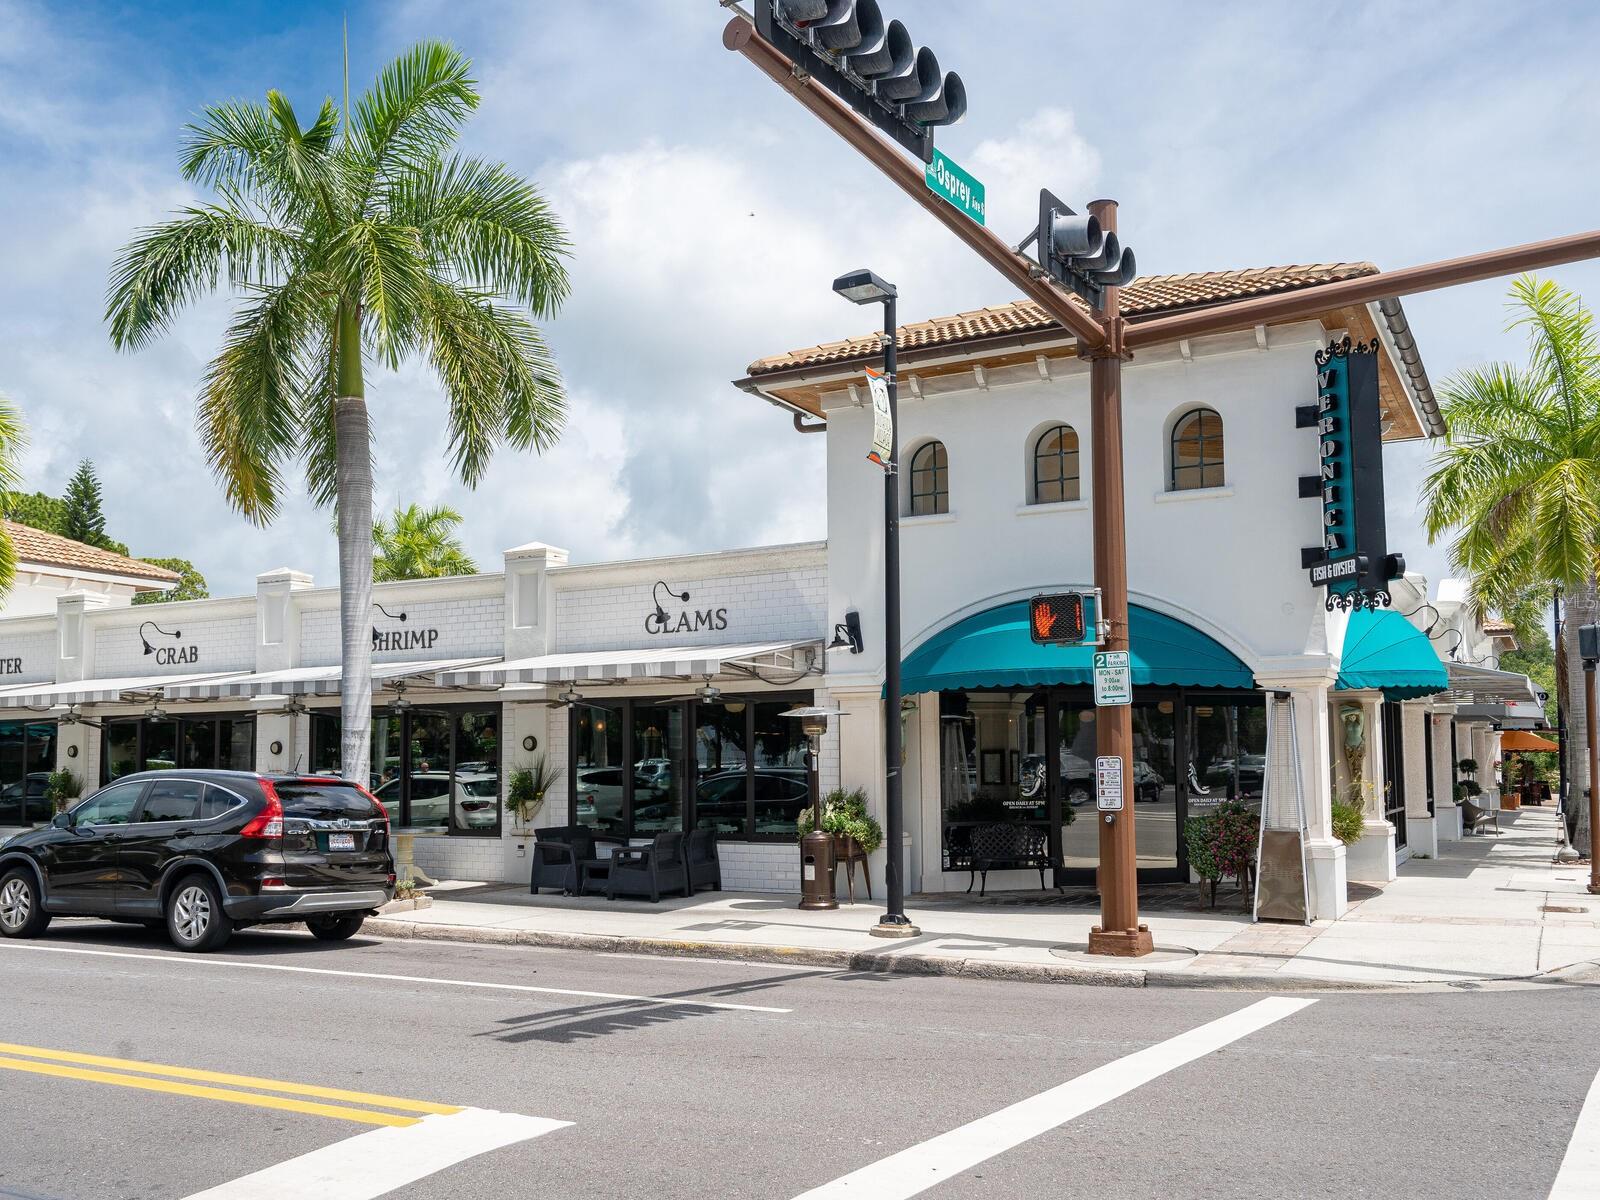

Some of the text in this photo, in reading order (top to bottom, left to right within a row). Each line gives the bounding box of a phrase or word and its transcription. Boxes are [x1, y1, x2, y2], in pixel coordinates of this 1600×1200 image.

[936, 158, 971, 210] Osprey
[971, 195, 981, 213] Ave
[1316, 367, 1343, 552] VERONICA
[1313, 558, 1357, 583] FISH & OYSTER
[645, 607, 728, 635] CLAMS
[156, 645, 199, 666] CRAB
[1096, 655, 1105, 667] 2
[1107, 659, 1127, 667] PARKING
[1114, 668, 1125, 676] SAT
